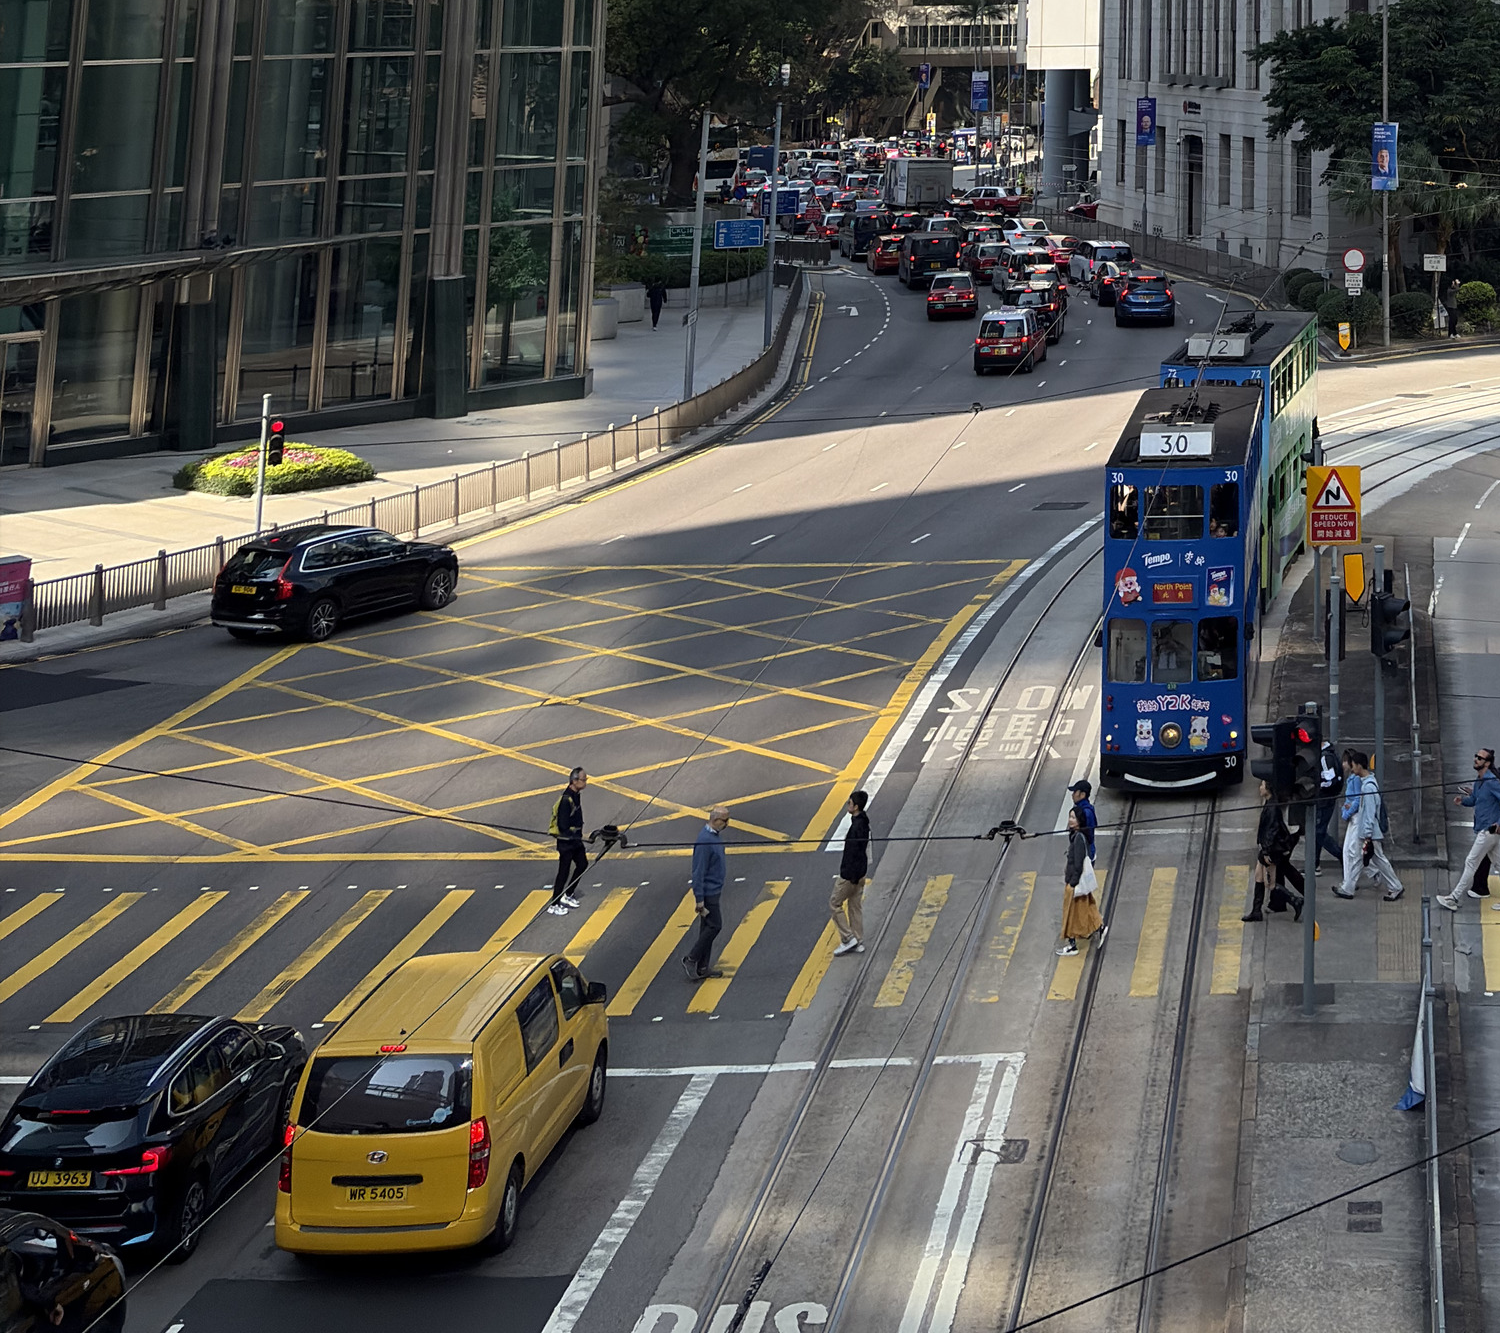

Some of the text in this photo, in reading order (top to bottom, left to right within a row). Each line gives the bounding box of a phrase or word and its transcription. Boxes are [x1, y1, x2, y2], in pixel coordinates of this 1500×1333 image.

[1167, 368, 1178, 378] 72
[1250, 369, 1261, 379] 72
[1160, 434, 1188, 454] 30
[1111, 472, 1124, 483] 30
[1224, 470, 1238, 482] 30
[1141, 552, 1173, 568] Tempo
[1174, 582, 1193, 590] Point
[937, 684, 1095, 714] SLOW
[1224, 755, 1237, 769] 30
[31, 1172, 89, 1185] UJ 3963
[349, 1187, 404, 1200] WR 5405
